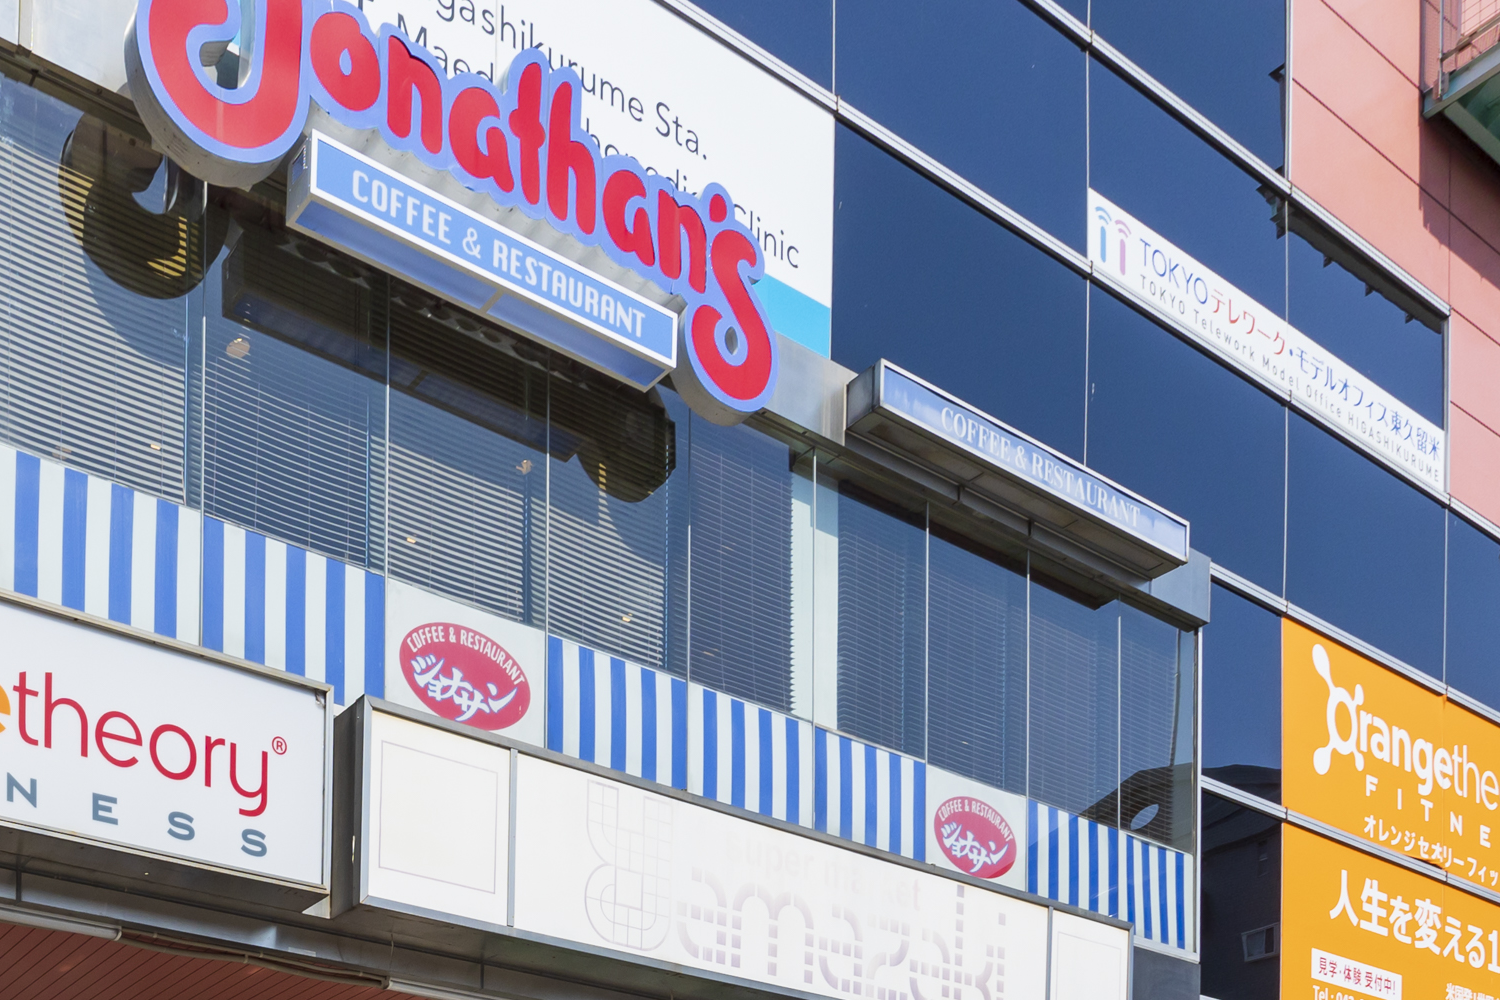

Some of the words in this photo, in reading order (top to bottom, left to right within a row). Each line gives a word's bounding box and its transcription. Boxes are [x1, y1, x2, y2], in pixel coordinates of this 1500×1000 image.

[656, 102, 708, 160] Sta.
[352, 170, 451, 245] COFFEE
[462, 227, 482, 259] &
[492, 241, 646, 338] RESTAURANT
[1140, 274, 1185, 315] TOKYO
[1193, 309, 1255, 362] Telework
[1262, 354, 1300, 391] Model
[1306, 385, 1341, 418] Office
[1348, 412, 1439, 483] HIGASHIKURUME
[941, 408, 1011, 460] COFFEE
[1014, 445, 1028, 472] &
[1031, 452, 1140, 529] RESTAURANT
[407, 626, 445, 652] COFFEE
[449, 627, 456, 643] &
[460, 629, 526, 685] RESTAURANT
[938, 799, 962, 821] COFFEE
[964, 799, 970, 812] &
[972, 801, 1013, 842] RESTAURANT
